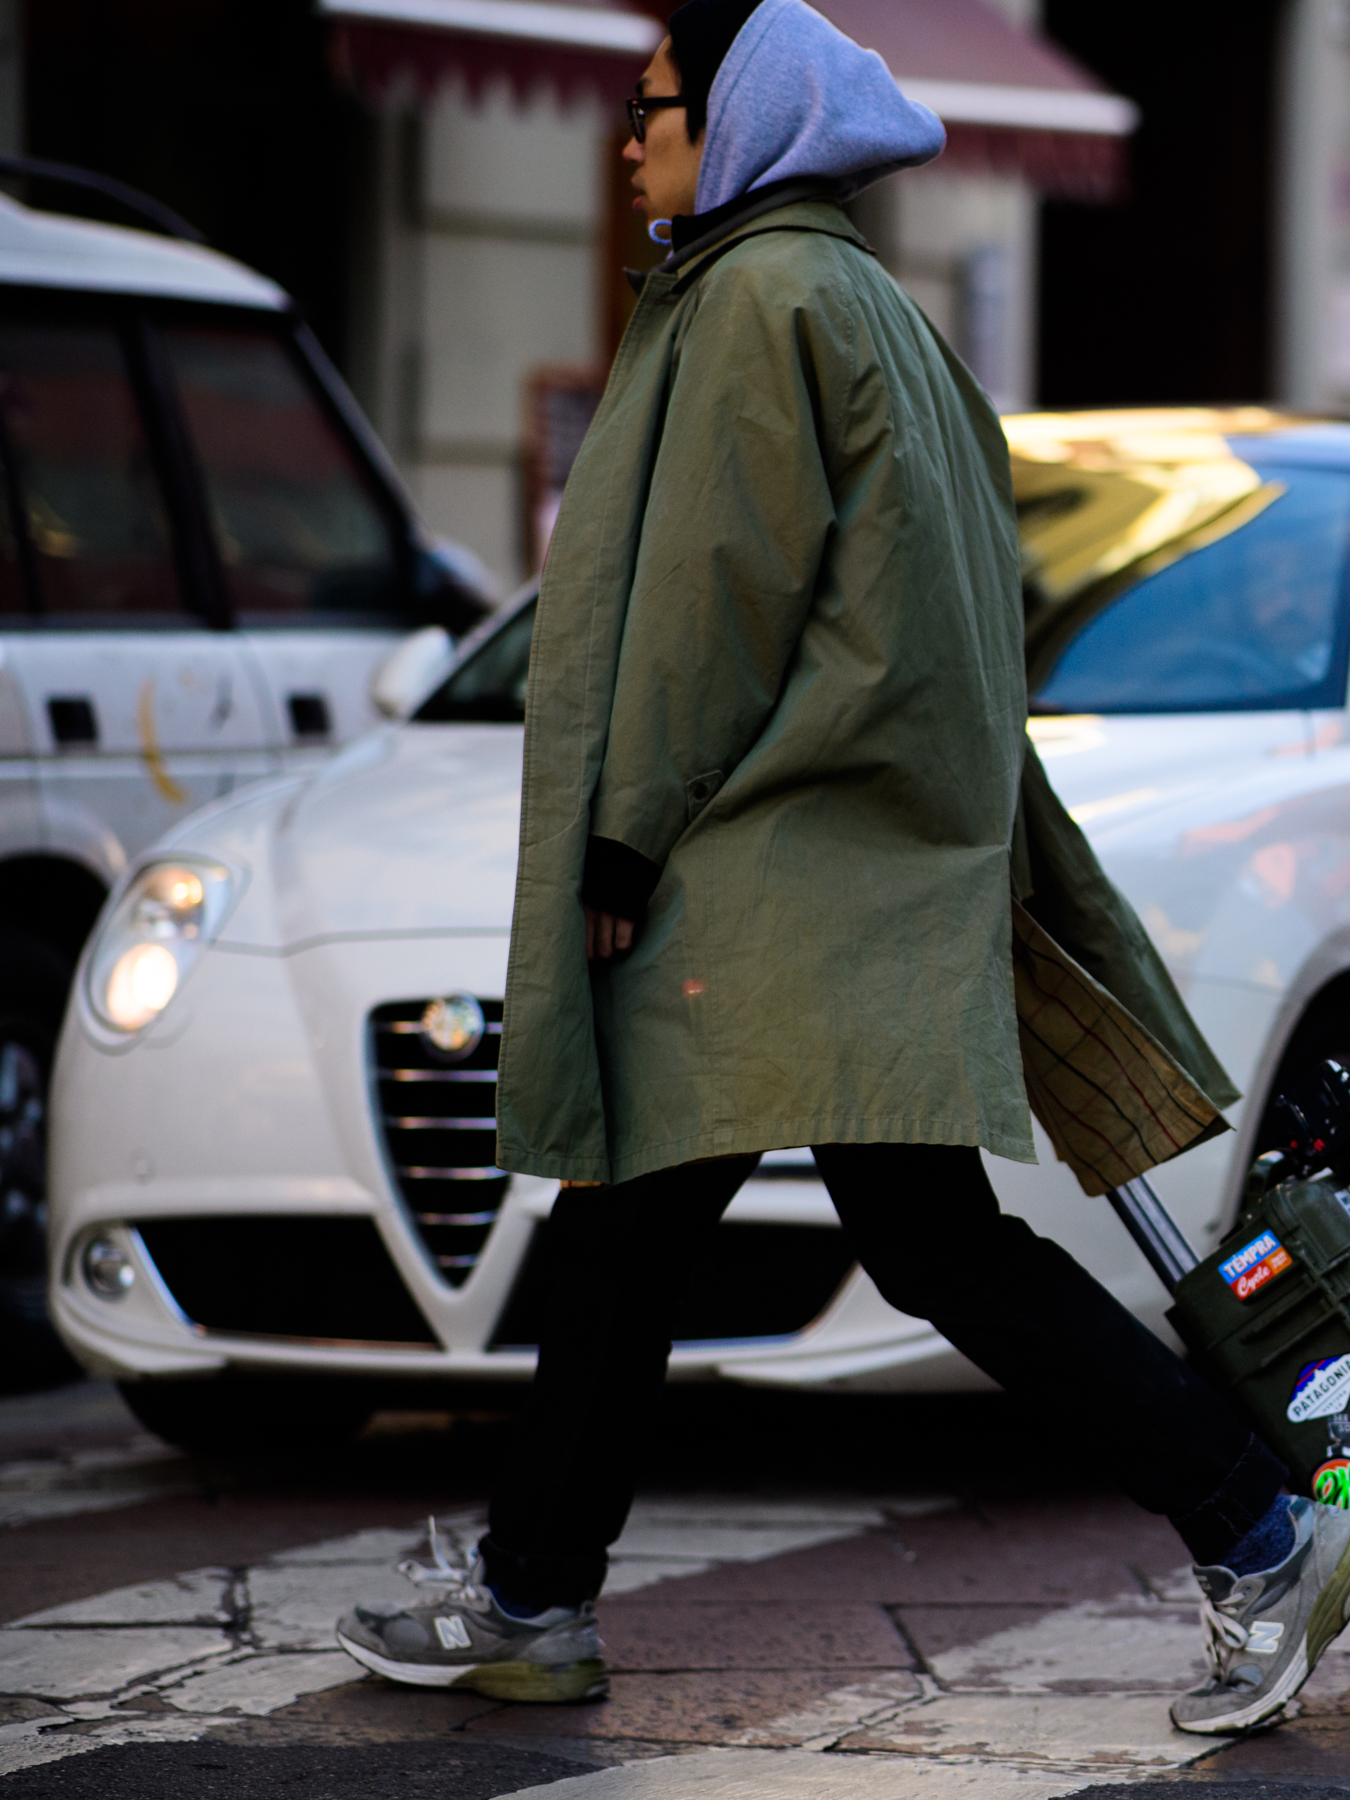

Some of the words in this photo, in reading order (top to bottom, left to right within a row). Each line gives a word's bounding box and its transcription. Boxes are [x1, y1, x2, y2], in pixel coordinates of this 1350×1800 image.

[1237, 1266, 1271, 1296] Cycle
[1334, 1413, 1349, 1421] SEE
[434, 1615, 472, 1650] N
